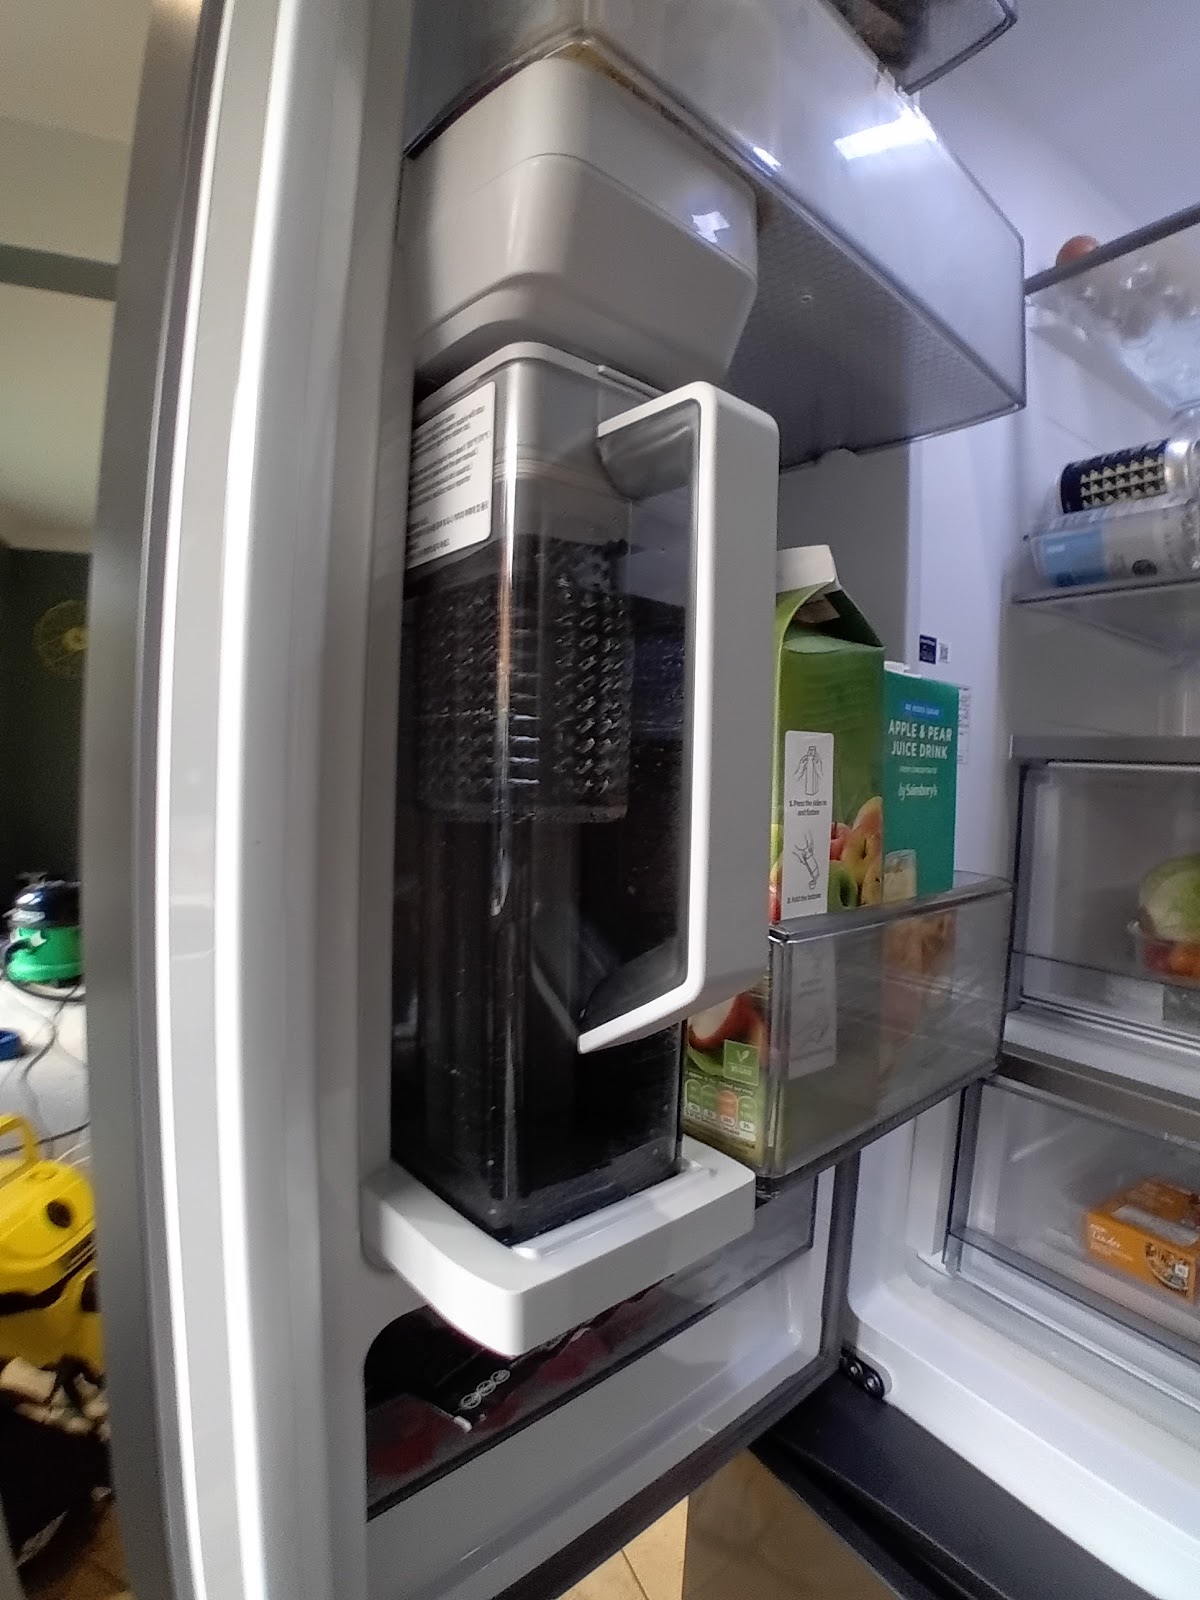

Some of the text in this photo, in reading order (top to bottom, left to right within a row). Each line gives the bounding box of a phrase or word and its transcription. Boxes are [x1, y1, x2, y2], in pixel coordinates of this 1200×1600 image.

[888, 718, 953, 742] APPLE & PEAR
[891, 740, 948, 760] JUICE DRINK
